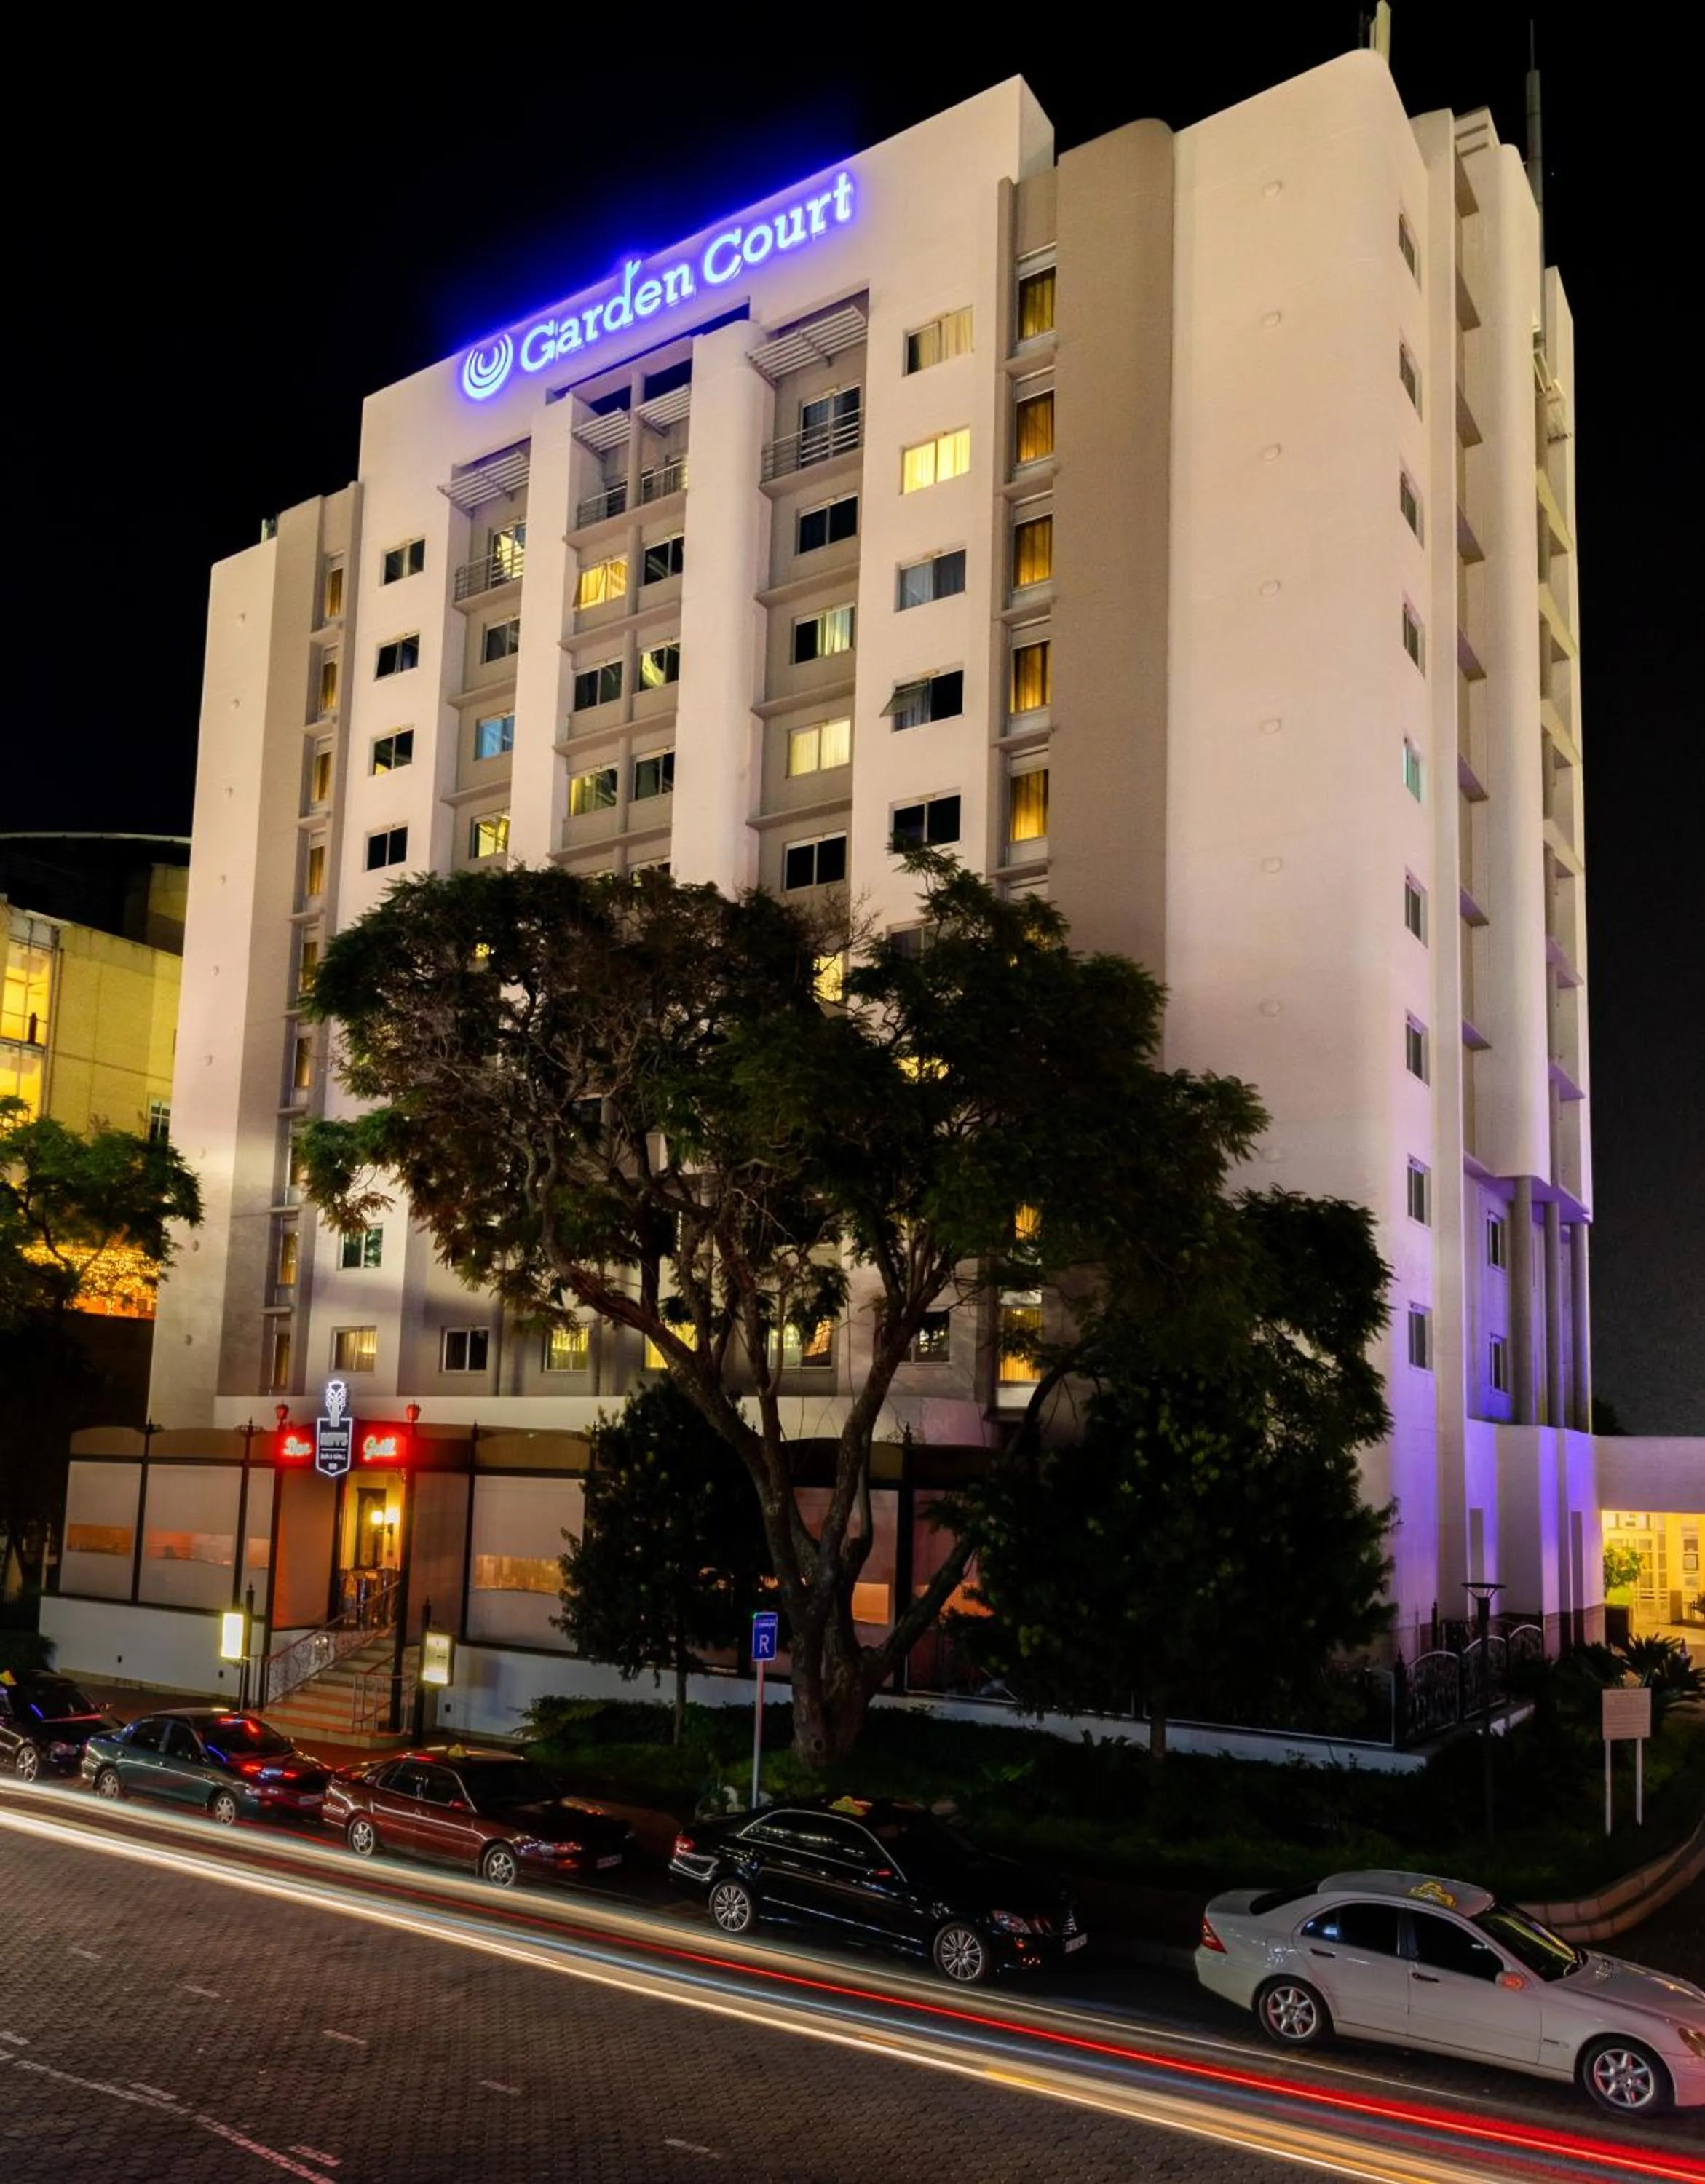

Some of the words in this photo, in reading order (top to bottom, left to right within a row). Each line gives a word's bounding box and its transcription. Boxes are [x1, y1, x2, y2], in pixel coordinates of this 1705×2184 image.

[519, 258, 694, 373] Garden
[703, 171, 854, 285] Court
[759, 1634, 770, 1654] R
